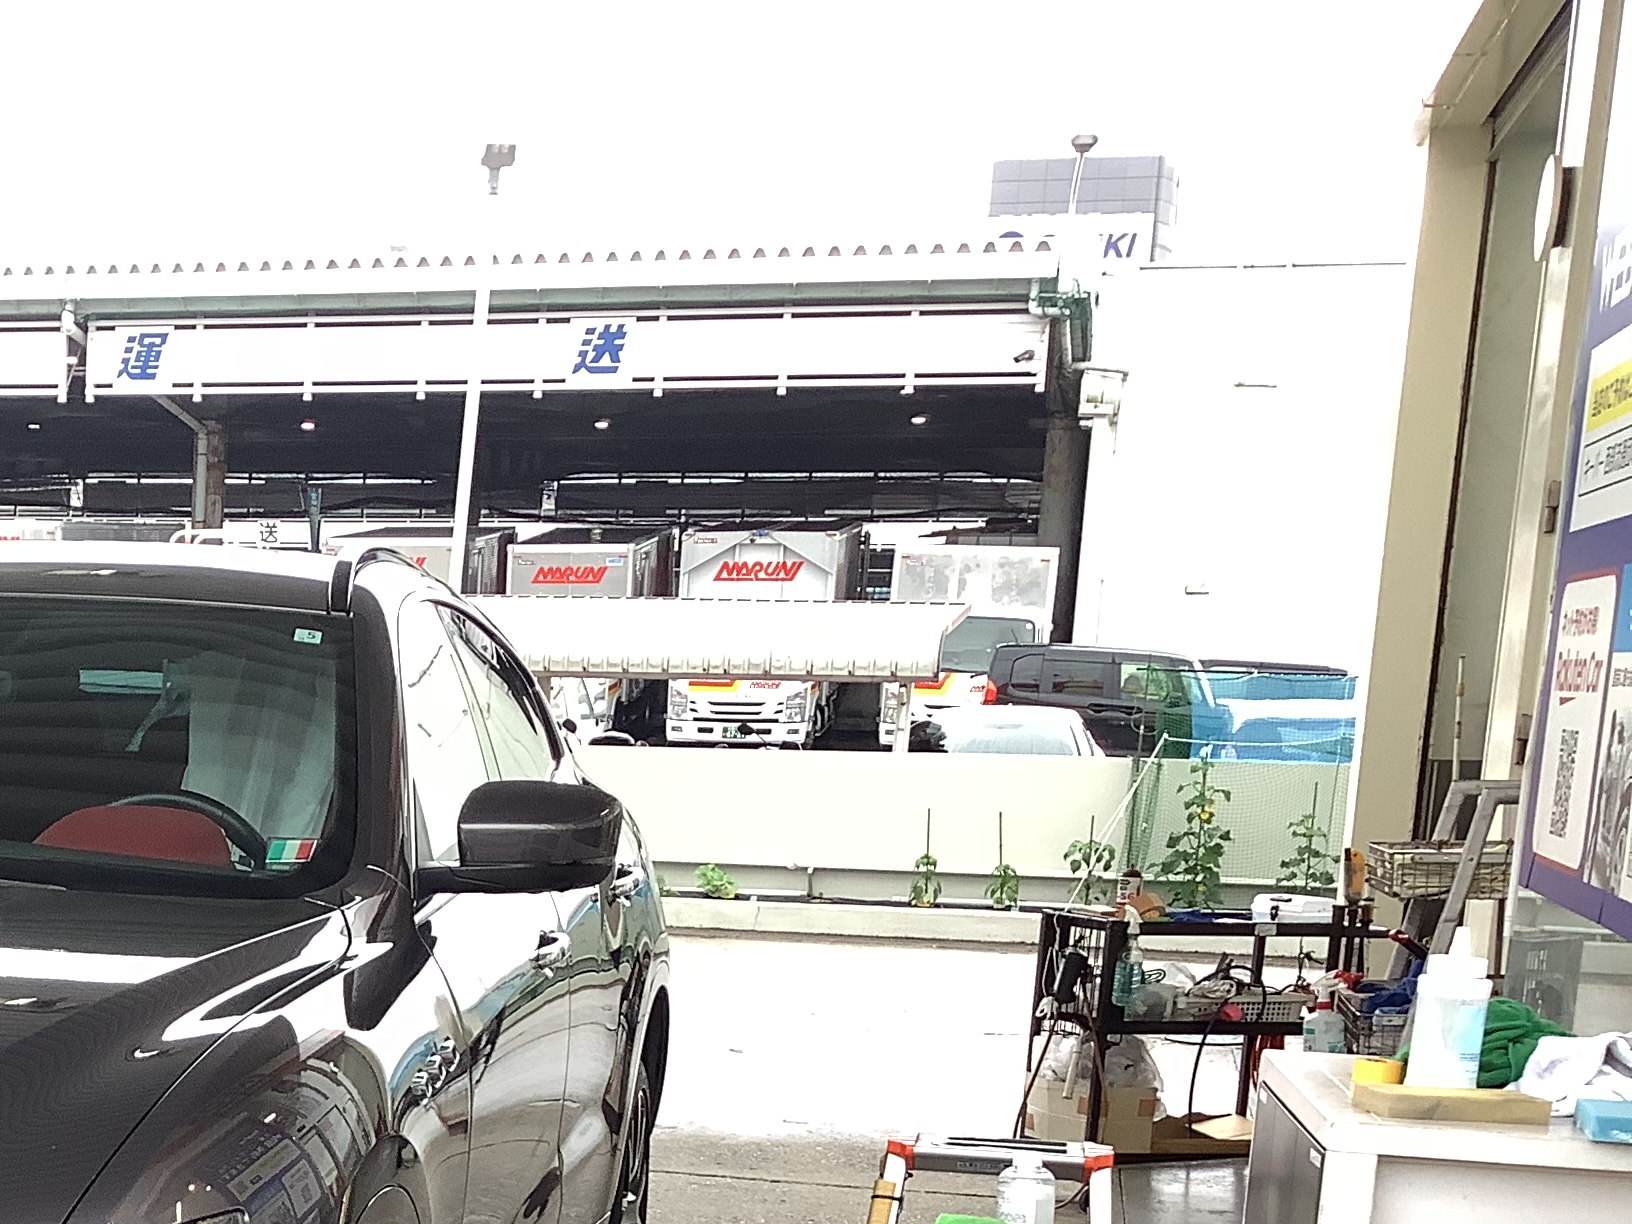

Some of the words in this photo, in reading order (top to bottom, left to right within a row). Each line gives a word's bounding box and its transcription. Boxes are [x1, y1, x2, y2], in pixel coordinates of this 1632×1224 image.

[117, 332, 170, 381] 運
[571, 323, 628, 375] 送
[259, 521, 278, 543] 送
[531, 565, 609, 585] MARUNI
[713, 560, 805, 582] MARUNI
[1585, 650, 1604, 694] Car
